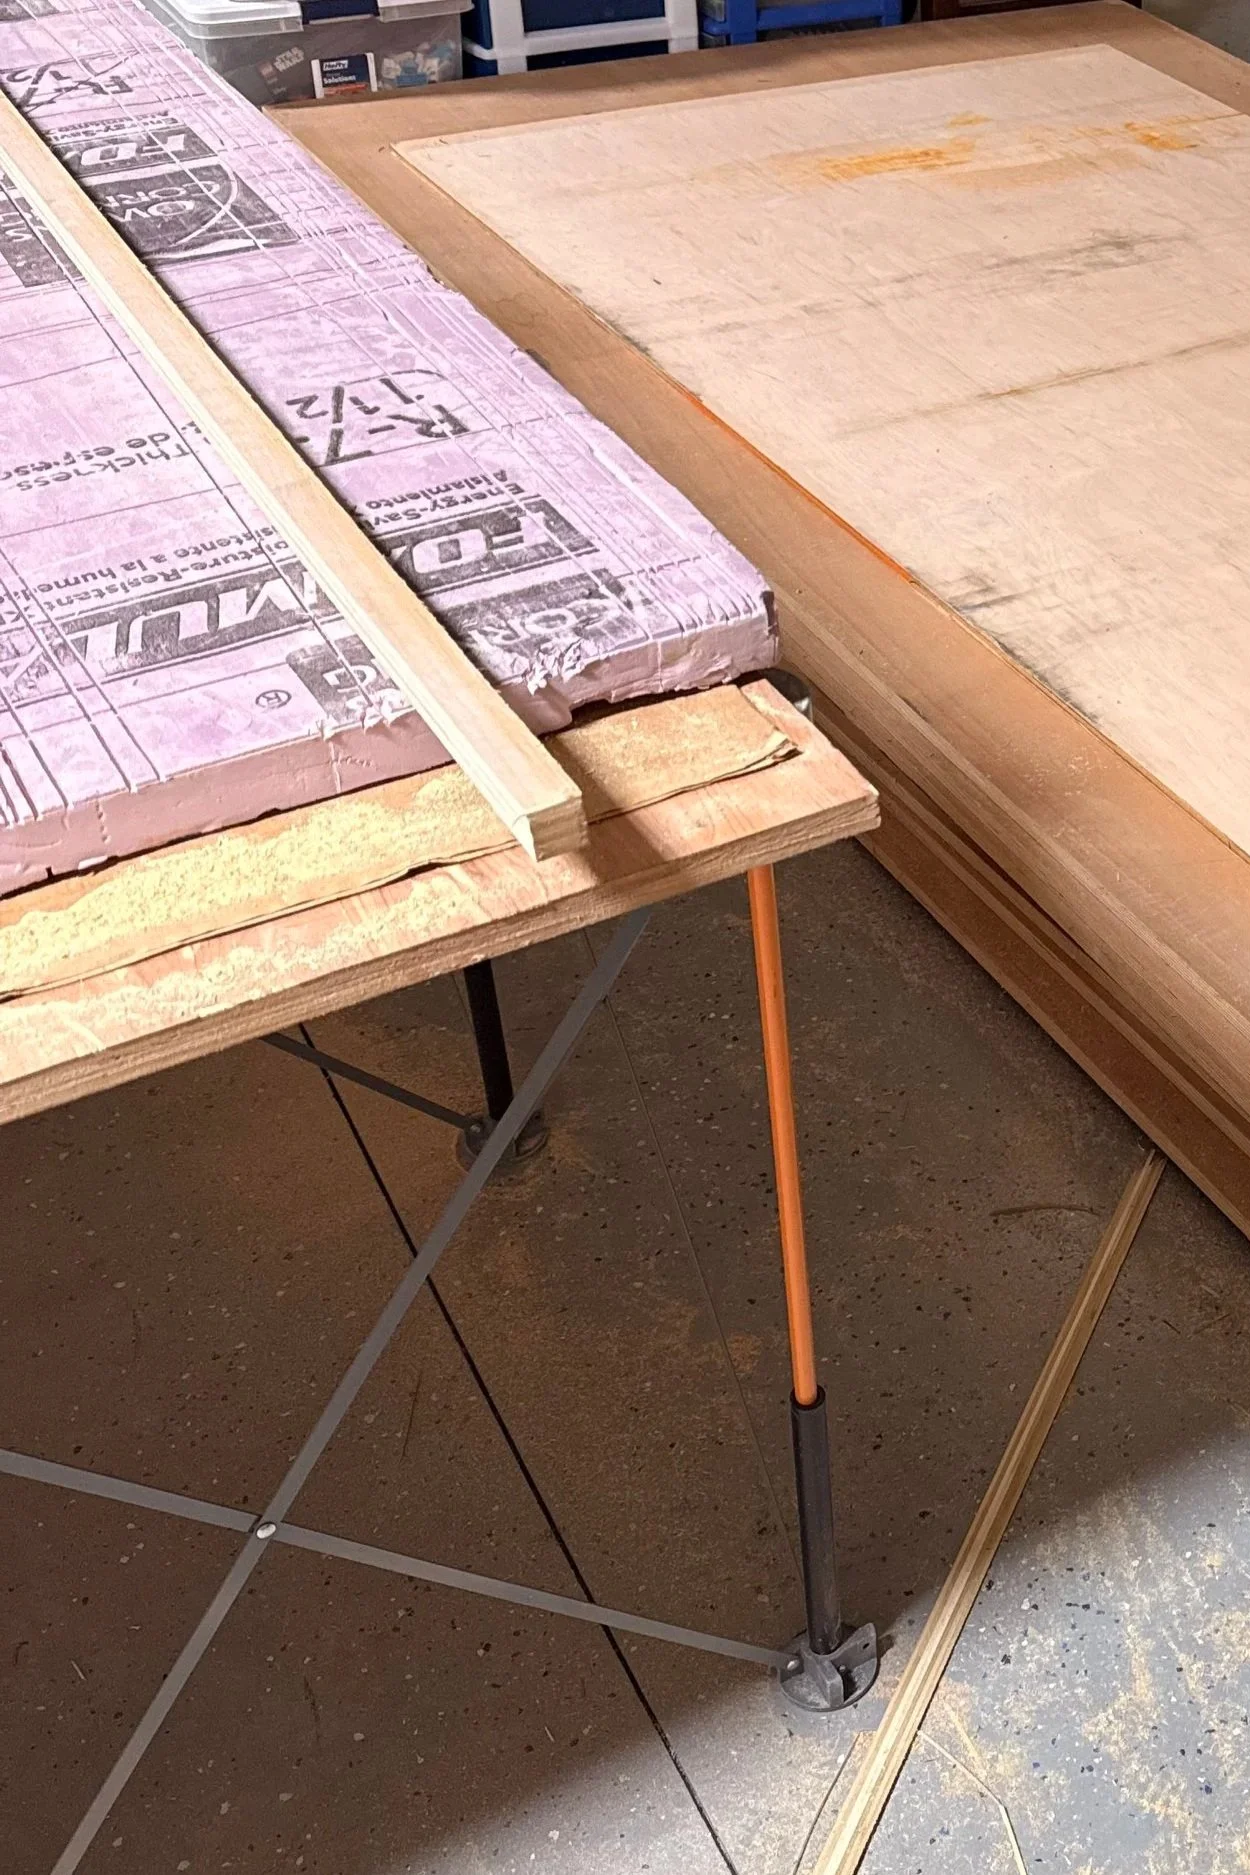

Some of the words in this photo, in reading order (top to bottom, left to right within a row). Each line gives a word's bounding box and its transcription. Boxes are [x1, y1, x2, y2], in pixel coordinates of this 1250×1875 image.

[324, 60, 348, 71] Hefty
[324, 75, 356, 85] Solutions
[126, 432, 171, 450] de
[16, 442, 191, 492] Thickness
[360, 480, 526, 533] Energy-Savi
[366, 470, 508, 513] Aislamiento
[174, 524, 280, 560] sistente
[44, 538, 290, 613] oisture-Resistant
[123, 557, 147, 573] la
